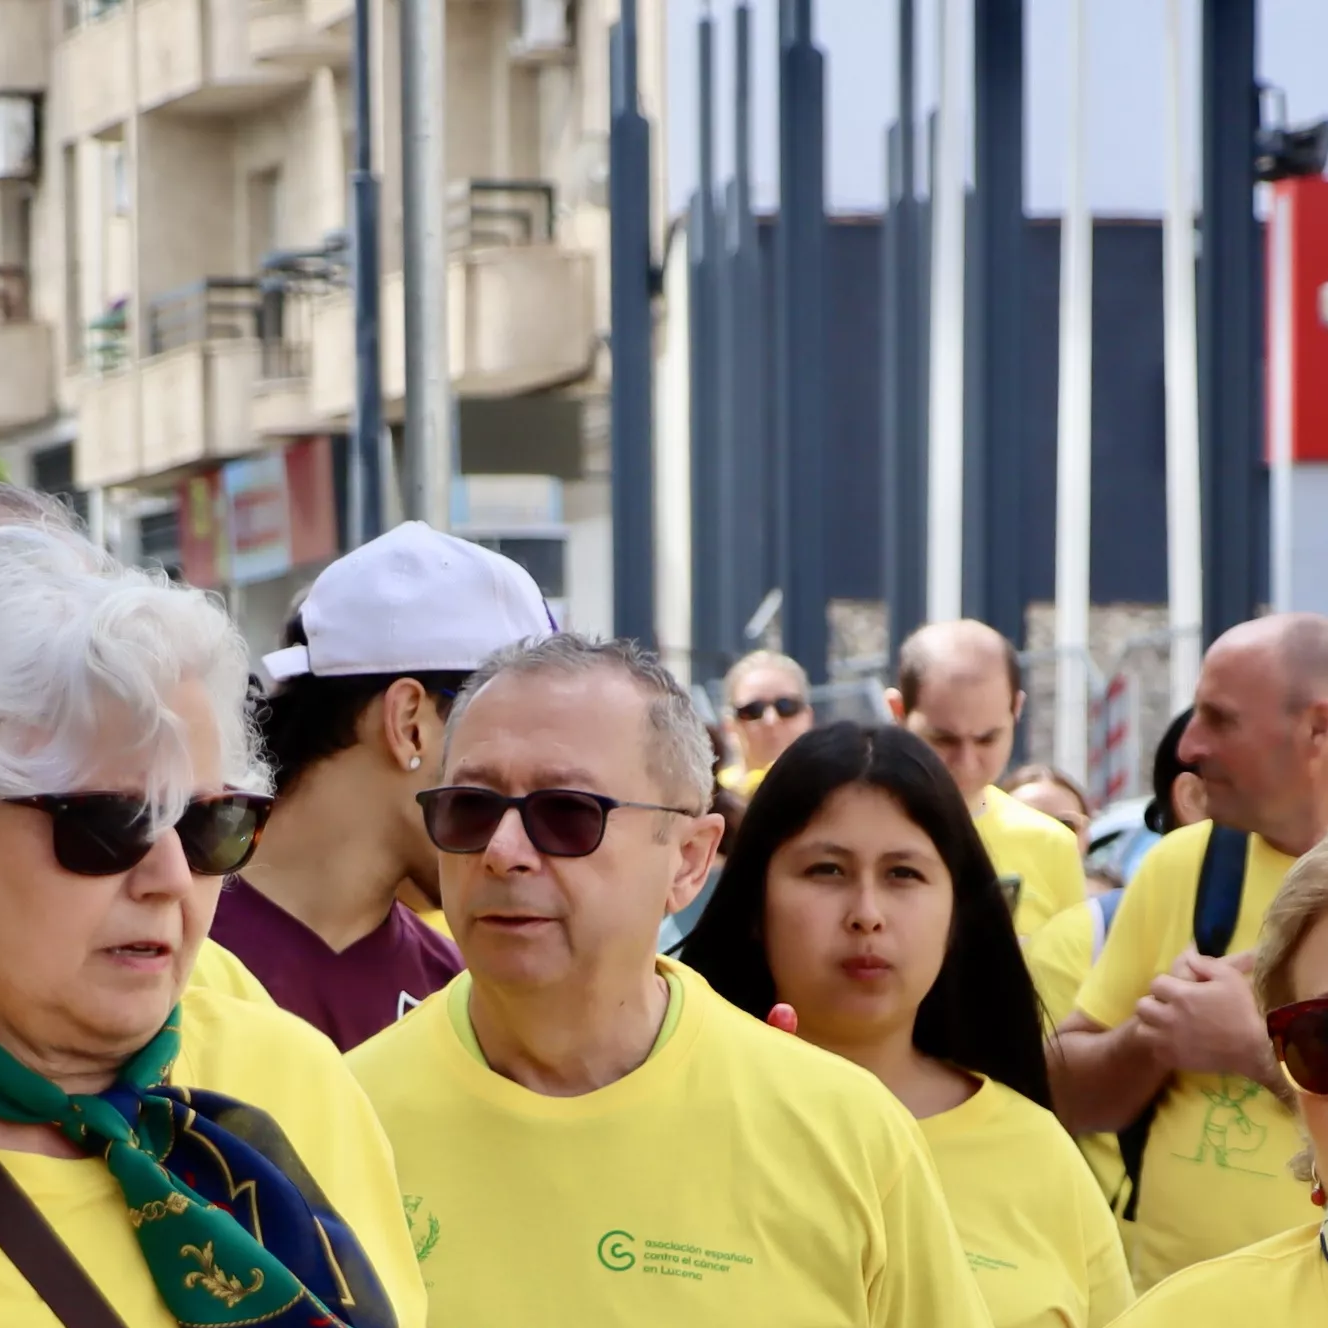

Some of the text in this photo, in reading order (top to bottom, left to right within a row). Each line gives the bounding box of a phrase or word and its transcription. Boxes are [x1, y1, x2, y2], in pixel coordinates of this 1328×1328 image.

[644, 1252, 679, 1263] contra
[681, 1256, 691, 1265] el
[645, 1240, 753, 1264] asociación española
[643, 1265, 703, 1280] en Lucena
